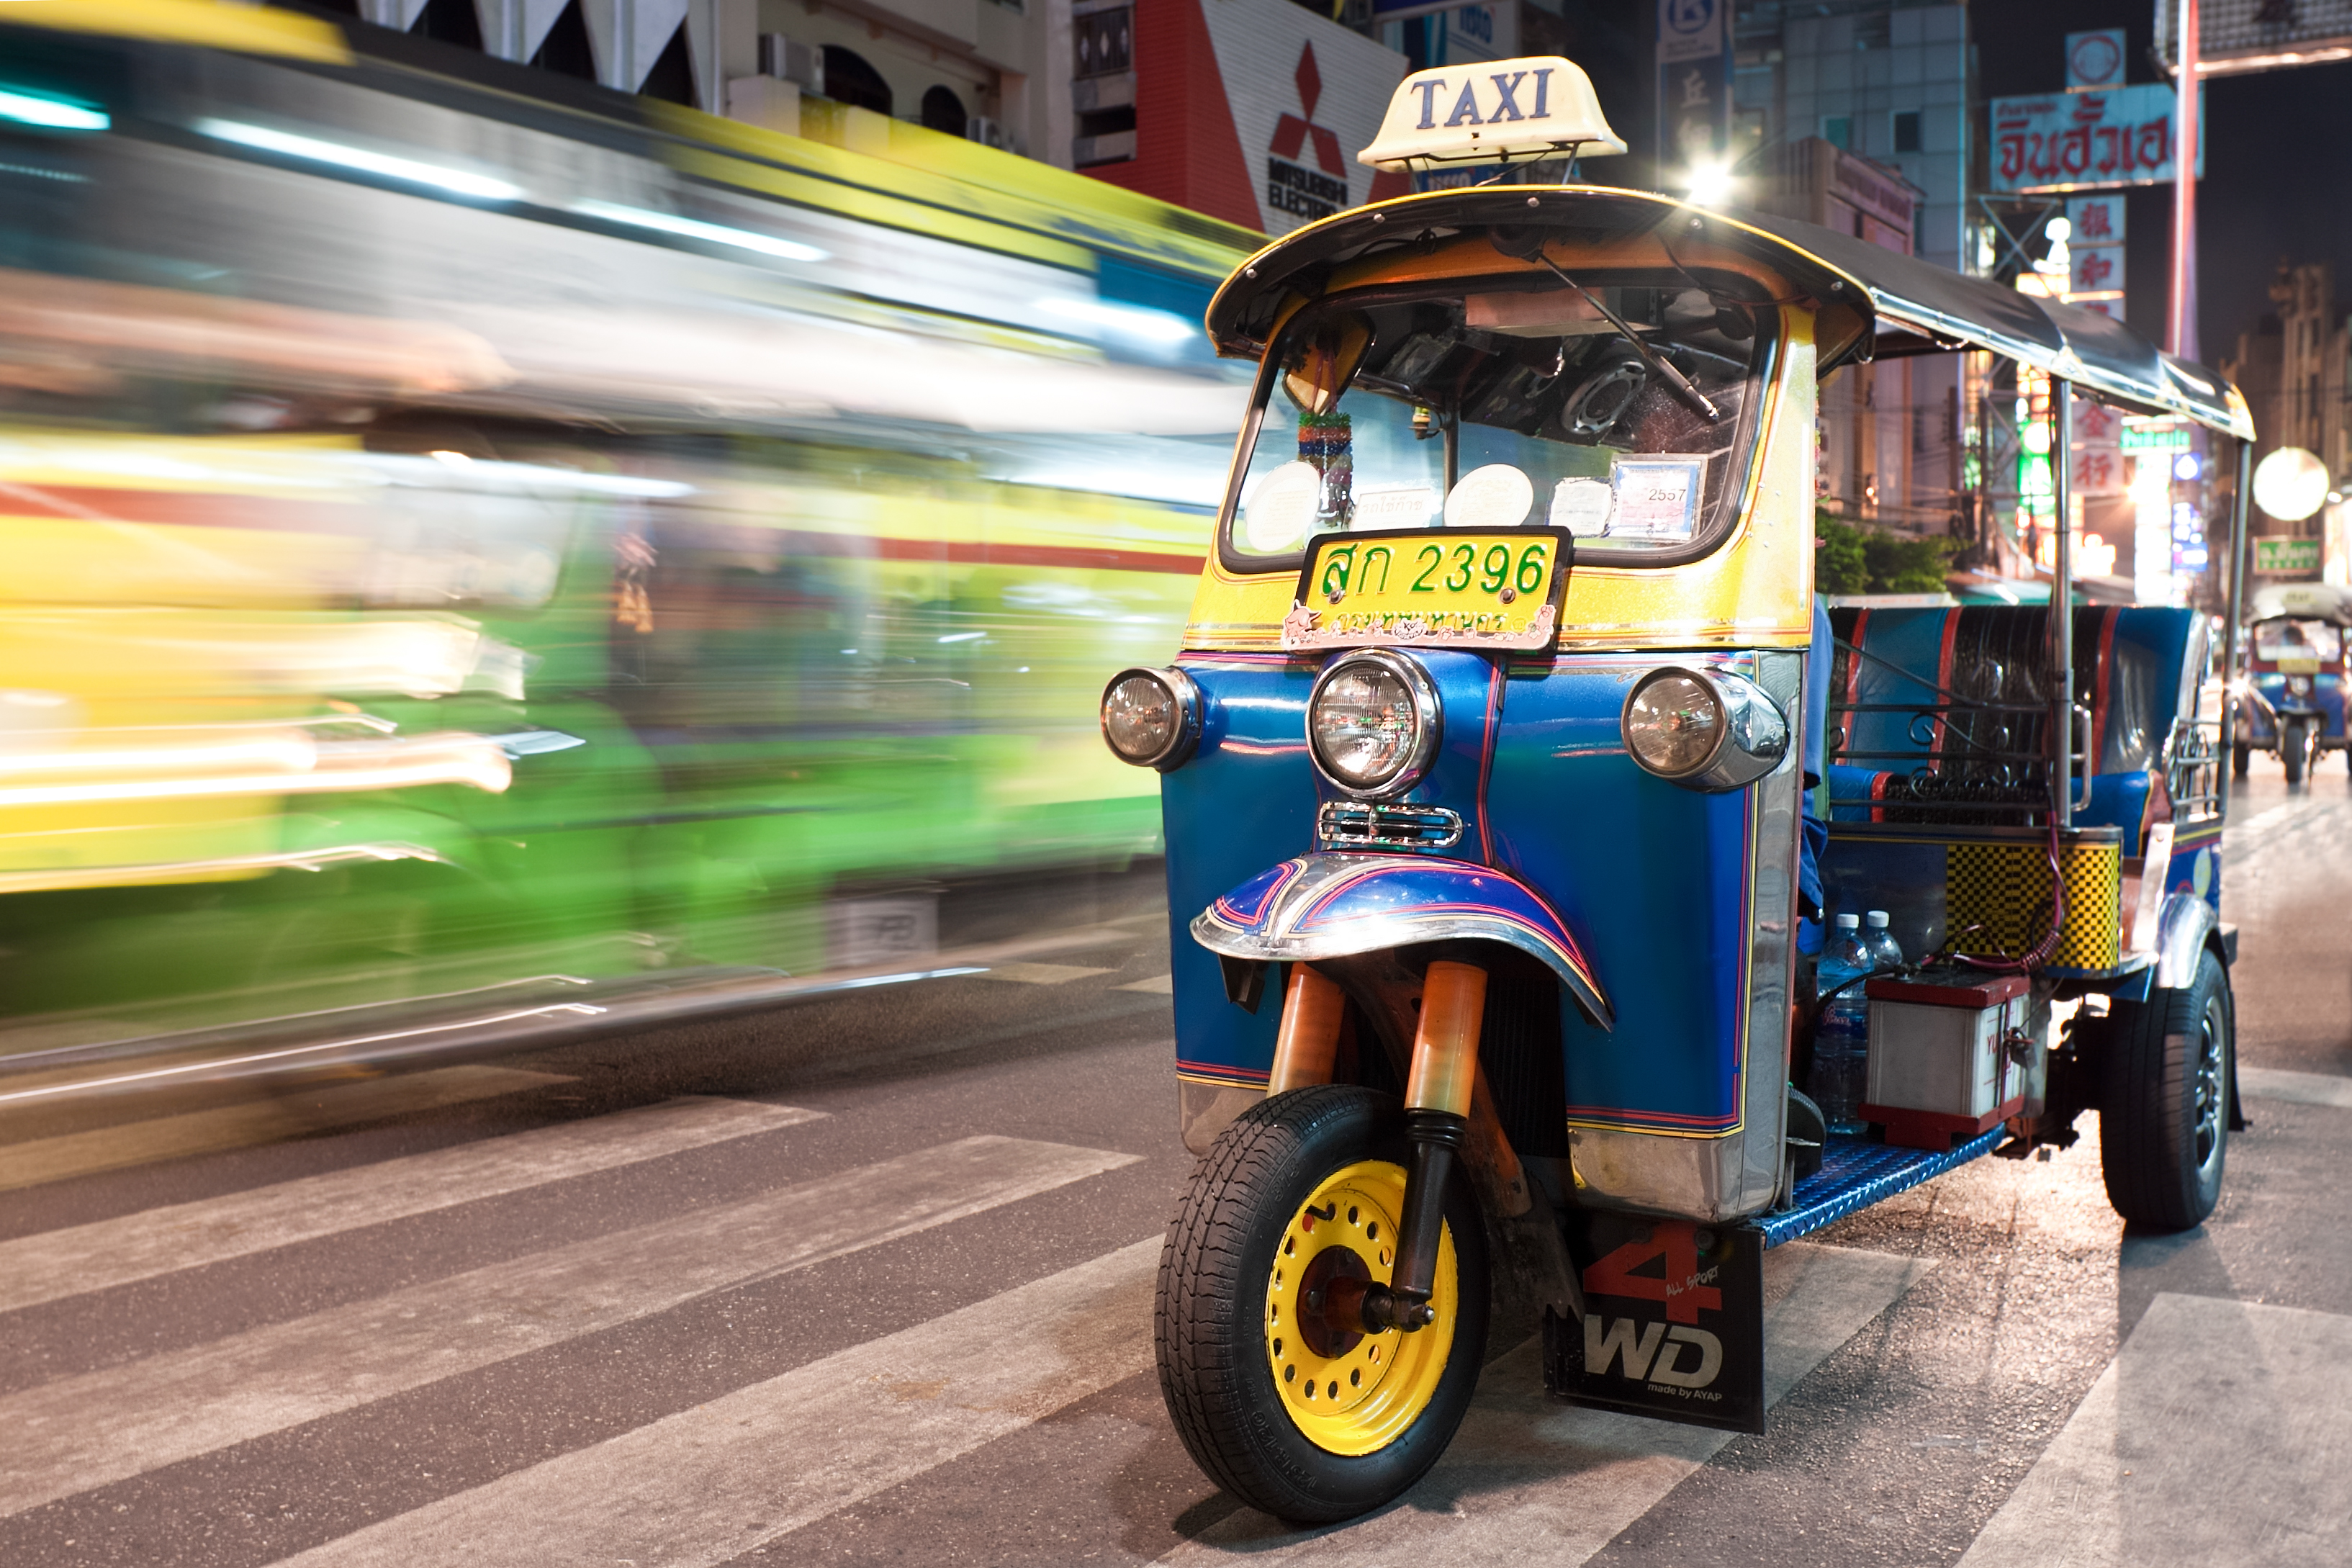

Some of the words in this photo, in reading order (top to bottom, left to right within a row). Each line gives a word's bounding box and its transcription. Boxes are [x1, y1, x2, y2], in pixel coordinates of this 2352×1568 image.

[1411, 68, 1554, 130] TAXI
[1997, 94, 2197, 180] จินฮั้วเฮ
[1269, 156, 1347, 207] MITSUBISHI
[1649, 488, 1686, 501] 2557
[1322, 541, 1394, 596] สก
[1409, 542, 1546, 595] 2396
[1582, 1222, 1722, 1325] 4
[1666, 1281, 1683, 1297] ALL
[1686, 1265, 1718, 1290] SPORT
[1584, 1313, 1723, 1389] WD
[1647, 1382, 1676, 1395] made
[1678, 1387, 1692, 1400] by
[1693, 1390, 1723, 1402] AYAP
